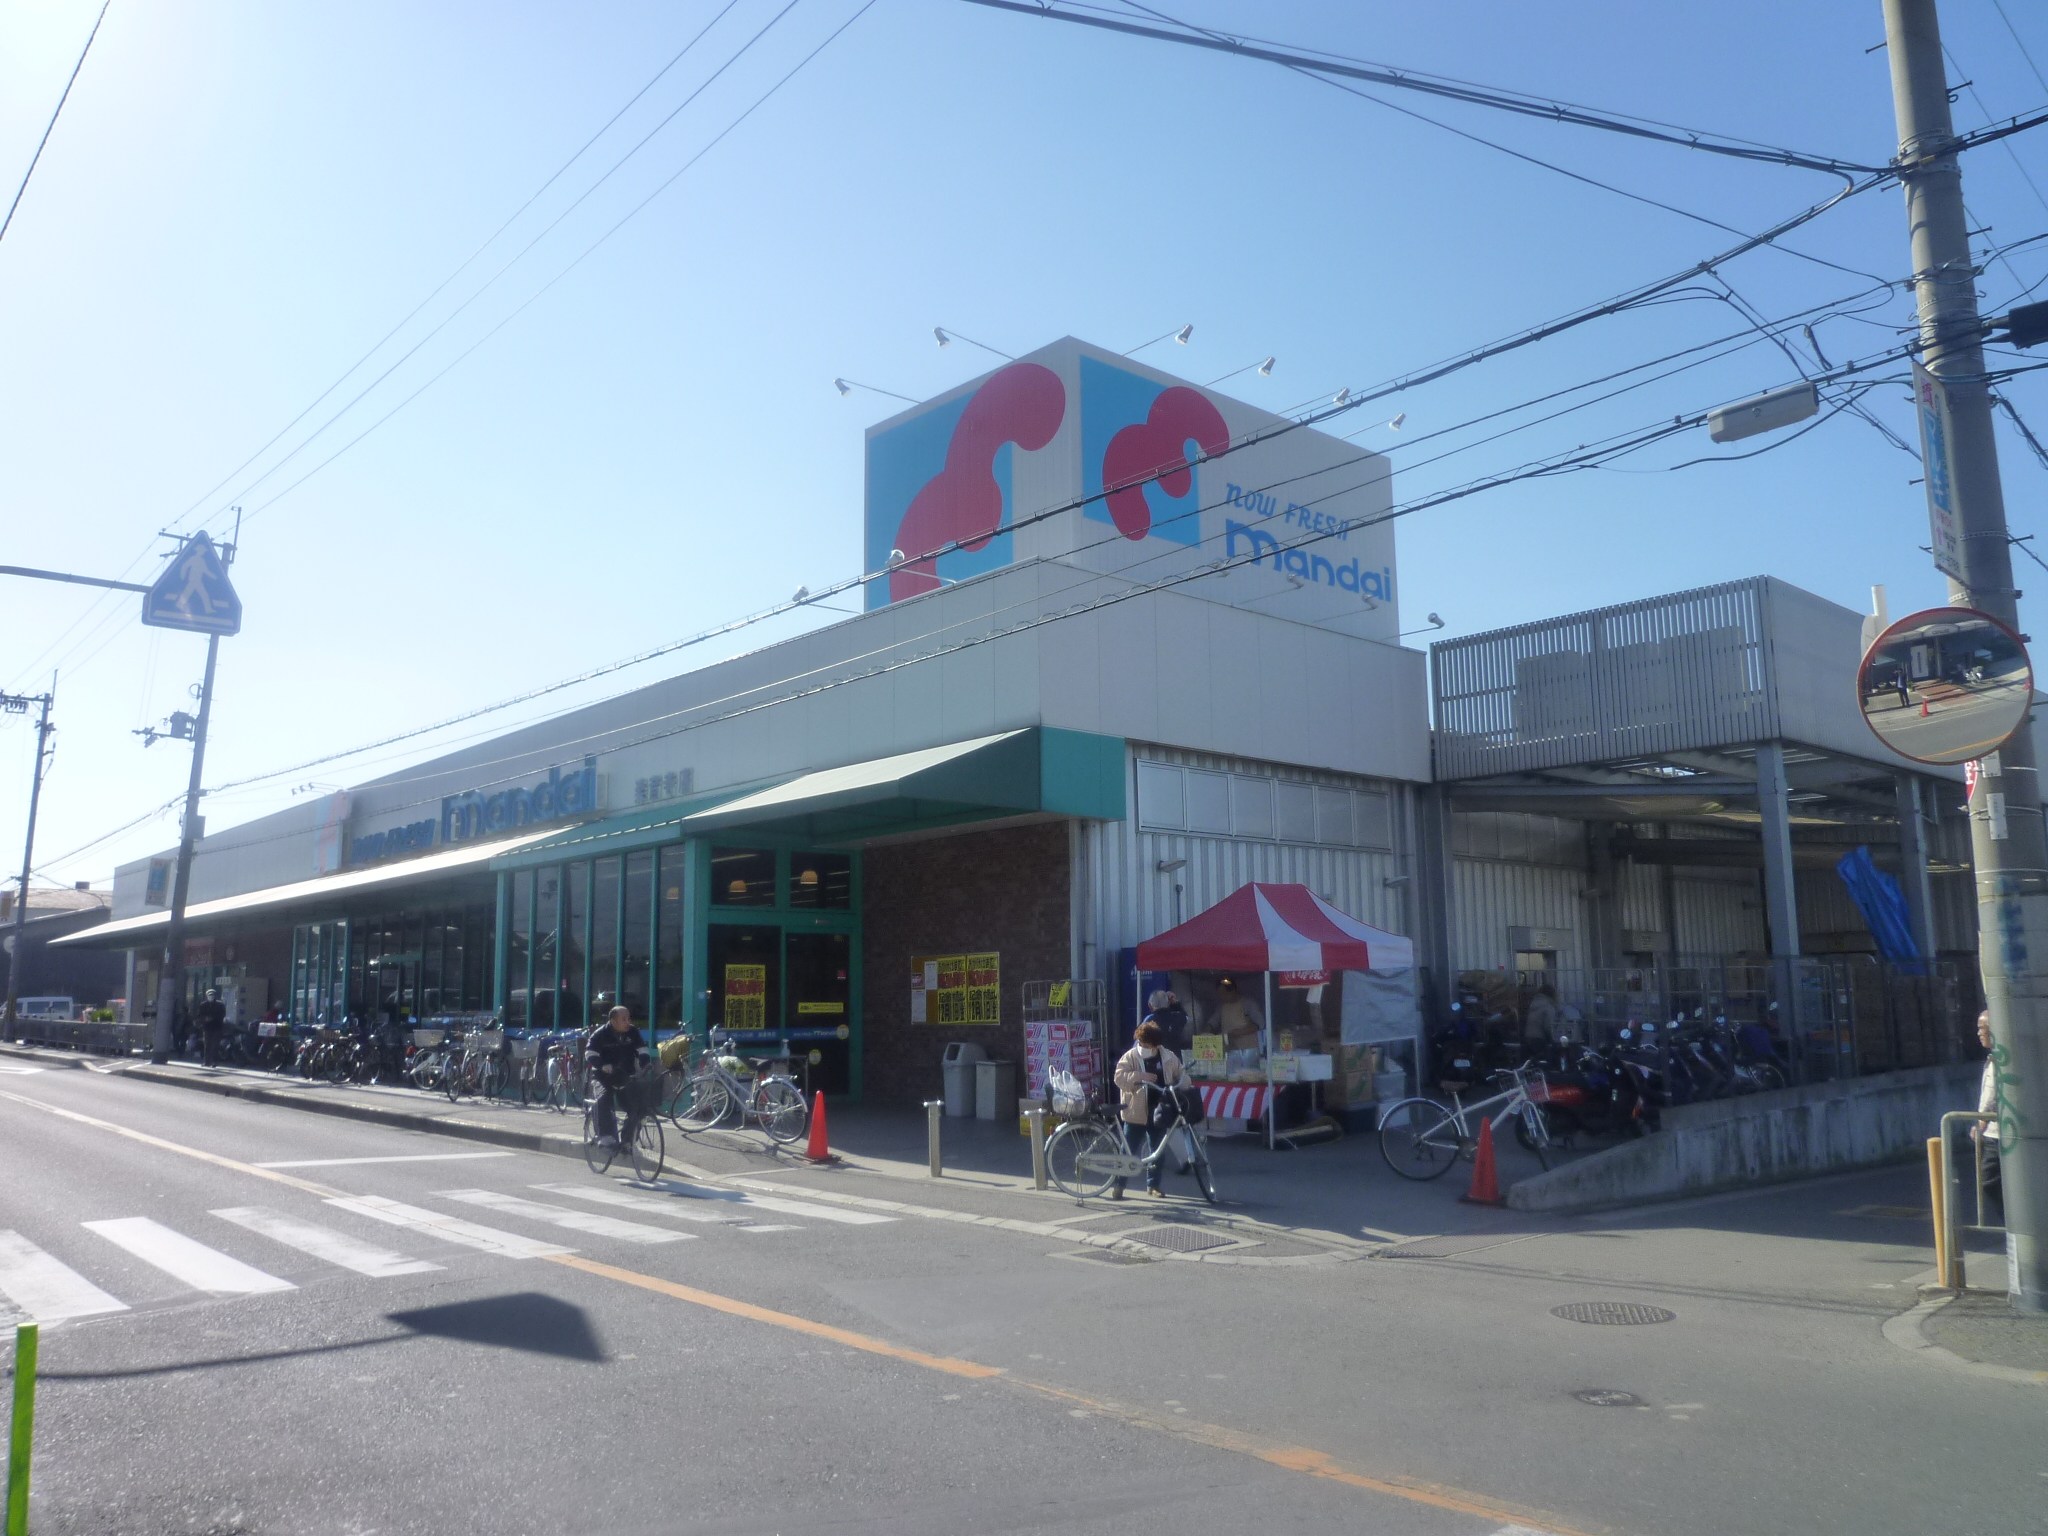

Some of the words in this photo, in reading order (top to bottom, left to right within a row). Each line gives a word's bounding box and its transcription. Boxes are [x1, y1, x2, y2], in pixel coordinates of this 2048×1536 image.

[1225, 518, 1391, 602] mandai
[1284, 502, 1350, 540] FRESH
[441, 753, 597, 842] mandai
